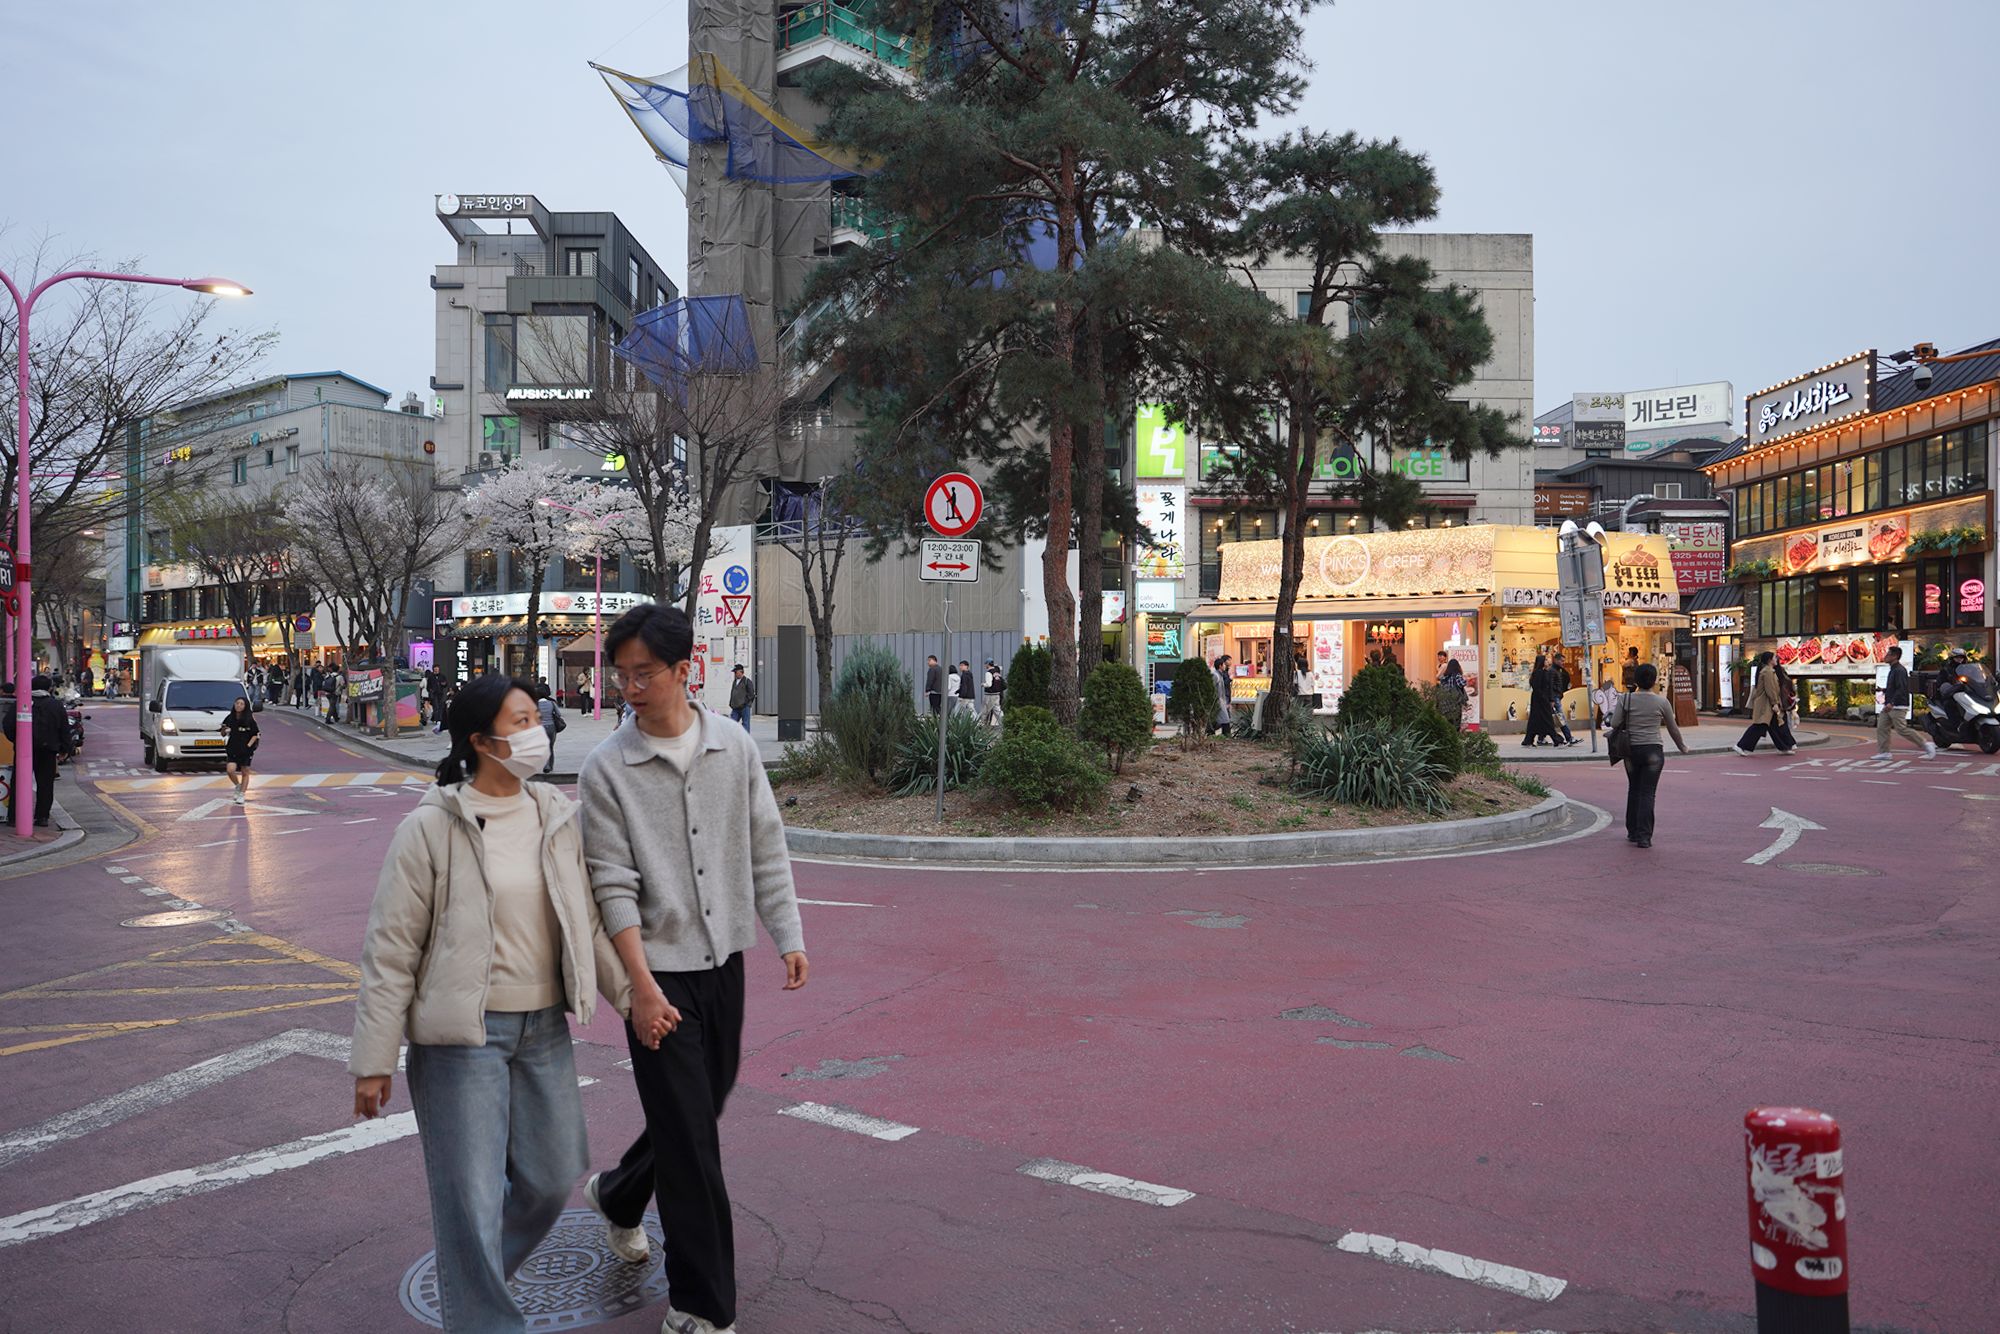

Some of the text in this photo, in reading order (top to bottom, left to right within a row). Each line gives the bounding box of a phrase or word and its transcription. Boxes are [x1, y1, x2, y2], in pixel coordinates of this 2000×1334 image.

[463, 197, 526, 212] 뉴코인싱어
[507, 389, 592, 400] MUSICPLANT
[1632, 394, 1697, 422] 게보린
[1160, 491, 1177, 561] 꽃게나라
[1679, 526, 1720, 547] 부동산
[1384, 555, 1427, 569] CREPE
